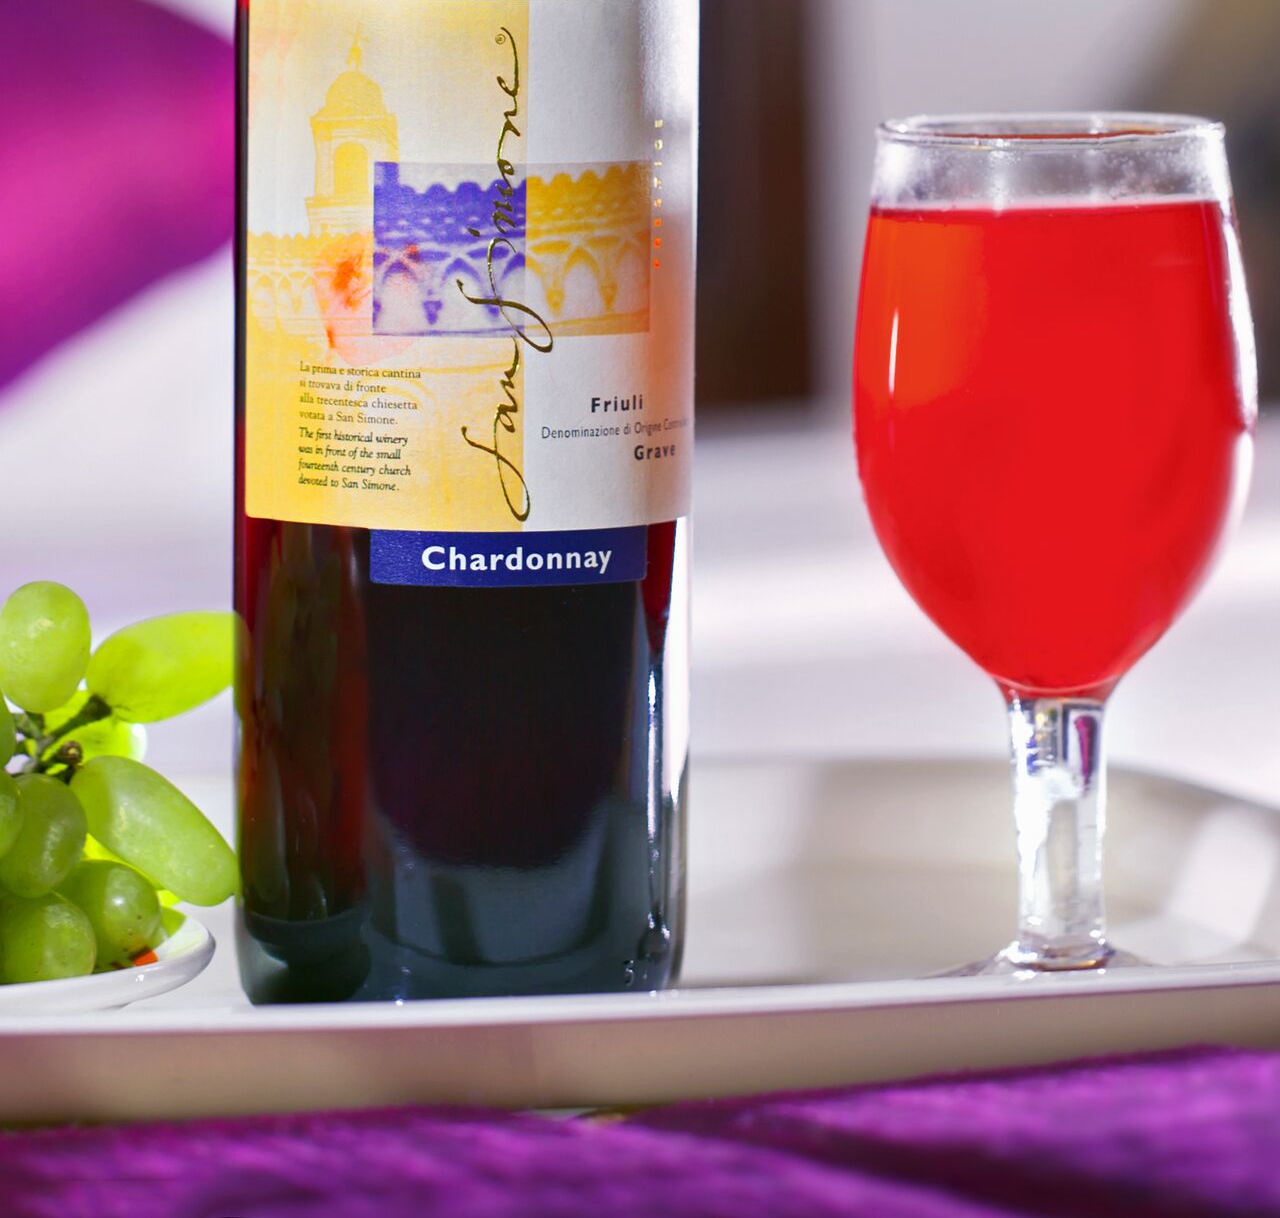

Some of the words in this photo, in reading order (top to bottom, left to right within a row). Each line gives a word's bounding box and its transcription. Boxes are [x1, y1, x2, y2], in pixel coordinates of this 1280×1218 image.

[300, 361, 310, 372] La
[312, 365, 337, 375] prima
[347, 367, 379, 377] storica
[382, 368, 421, 379] cantina
[300, 380, 307, 388] si
[308, 380, 341, 390] trovava
[344, 381, 353, 391] di
[356, 381, 387, 393] fronte
[300, 392, 314, 404] alla
[316, 396, 368, 408] trecentesca
[371, 398, 418, 410] chiesetta
[591, 394, 643, 413] Friuli
[299, 410, 325, 420] votata
[336, 411, 354, 423] San
[357, 413, 398, 425] Simone.
[299, 427, 314, 438] The
[315, 428, 332, 441] first
[334, 430, 373, 443] historical
[375, 433, 408, 446] winery
[461, 335, 531, 522] San
[541, 425, 620, 439] Denominazione
[623, 422, 632, 435] di
[298, 445, 313, 454] was
[315, 446, 323, 455] in
[324, 445, 346, 458] front
[348, 447, 358, 460] of
[360, 447, 374, 459] the
[376, 449, 401, 460] small
[634, 444, 676, 460] Grave
[298, 458, 339, 471] fourteenth
[342, 463, 375, 477] century
[379, 463, 411, 476] church
[298, 473, 328, 486] devoted
[330, 479, 339, 488] to
[342, 477, 359, 489] San
[362, 478, 400, 491] Simone.
[421, 545, 613, 575] Chardonnay
